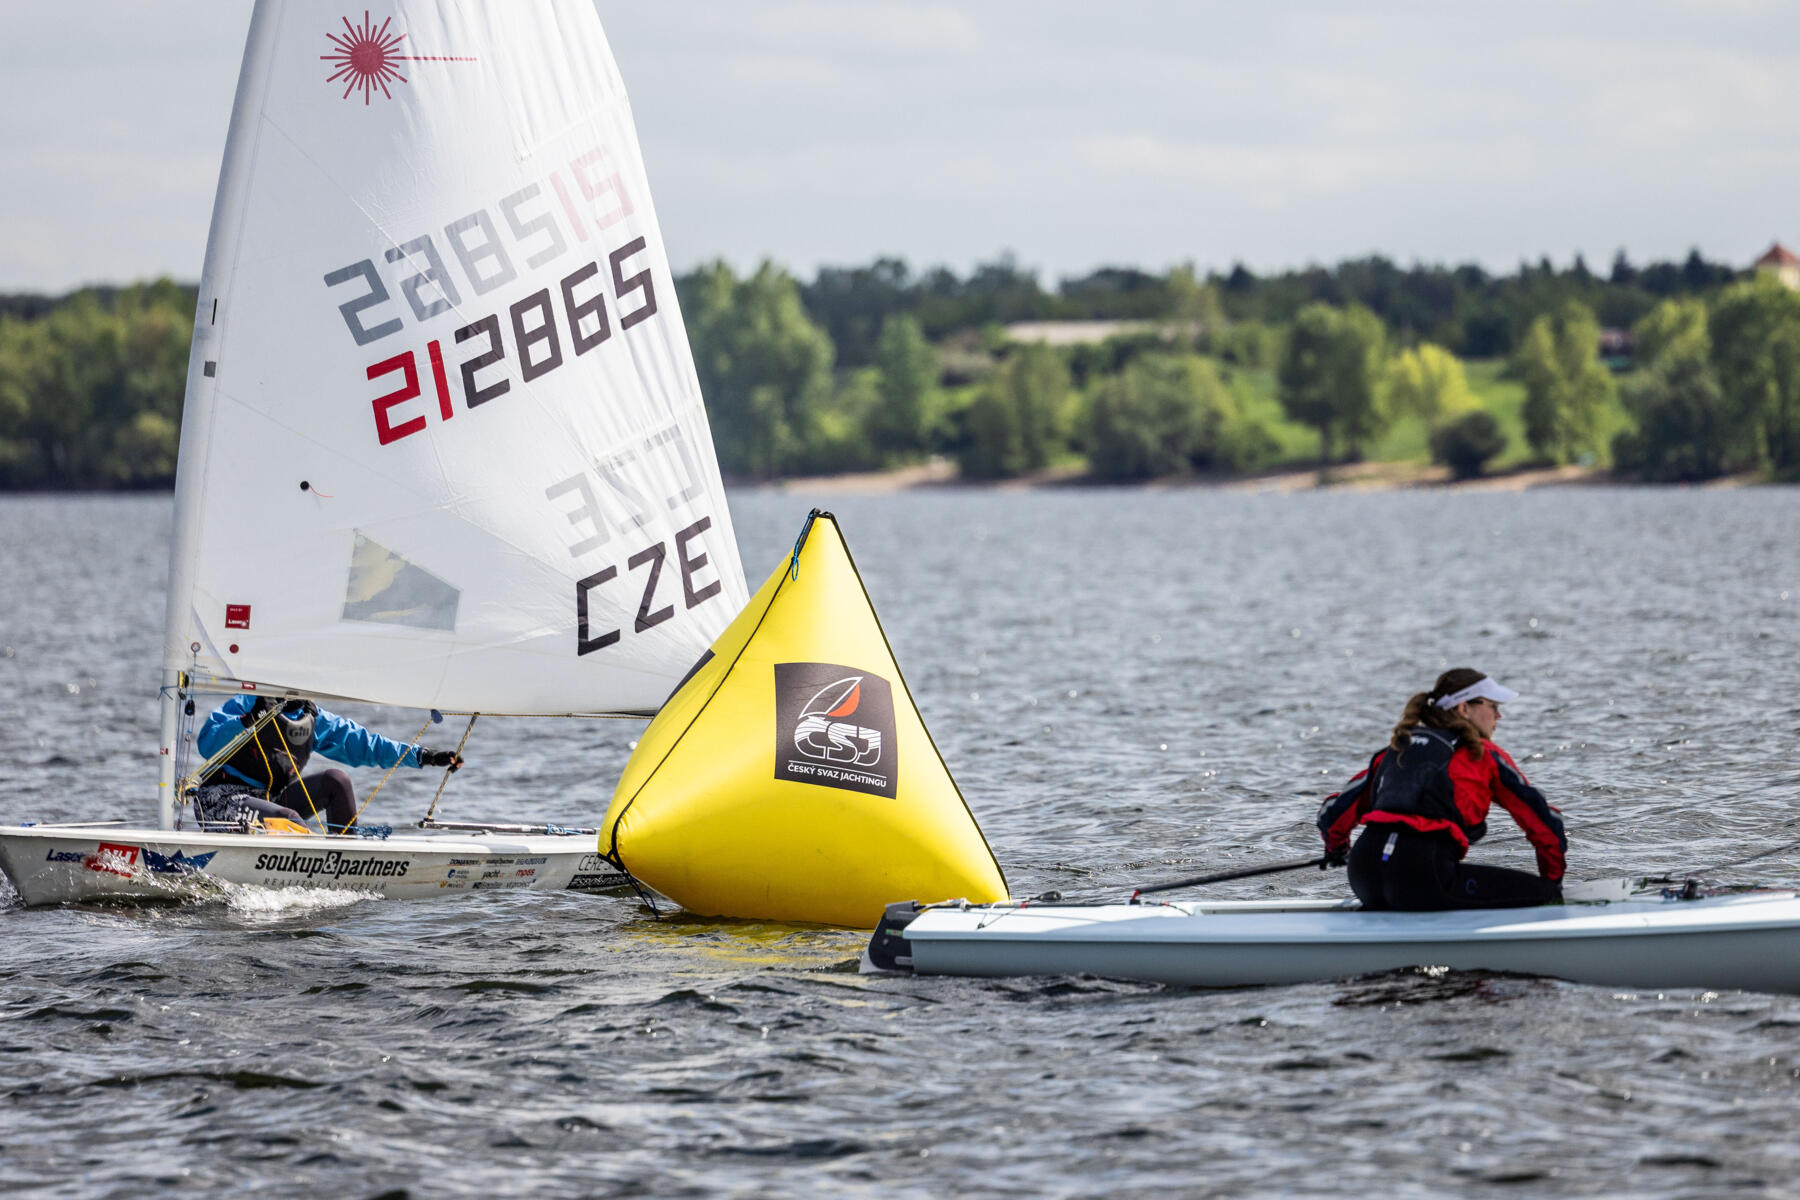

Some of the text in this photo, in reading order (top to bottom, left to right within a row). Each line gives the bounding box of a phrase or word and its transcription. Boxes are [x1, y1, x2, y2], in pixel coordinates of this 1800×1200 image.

[366, 236, 658, 446] 212865
[576, 515, 722, 657] CZE
[787, 763, 887, 788] ČESKÝ SVAZ JACHTINGU
[255, 851, 410, 880] soukup&partners
